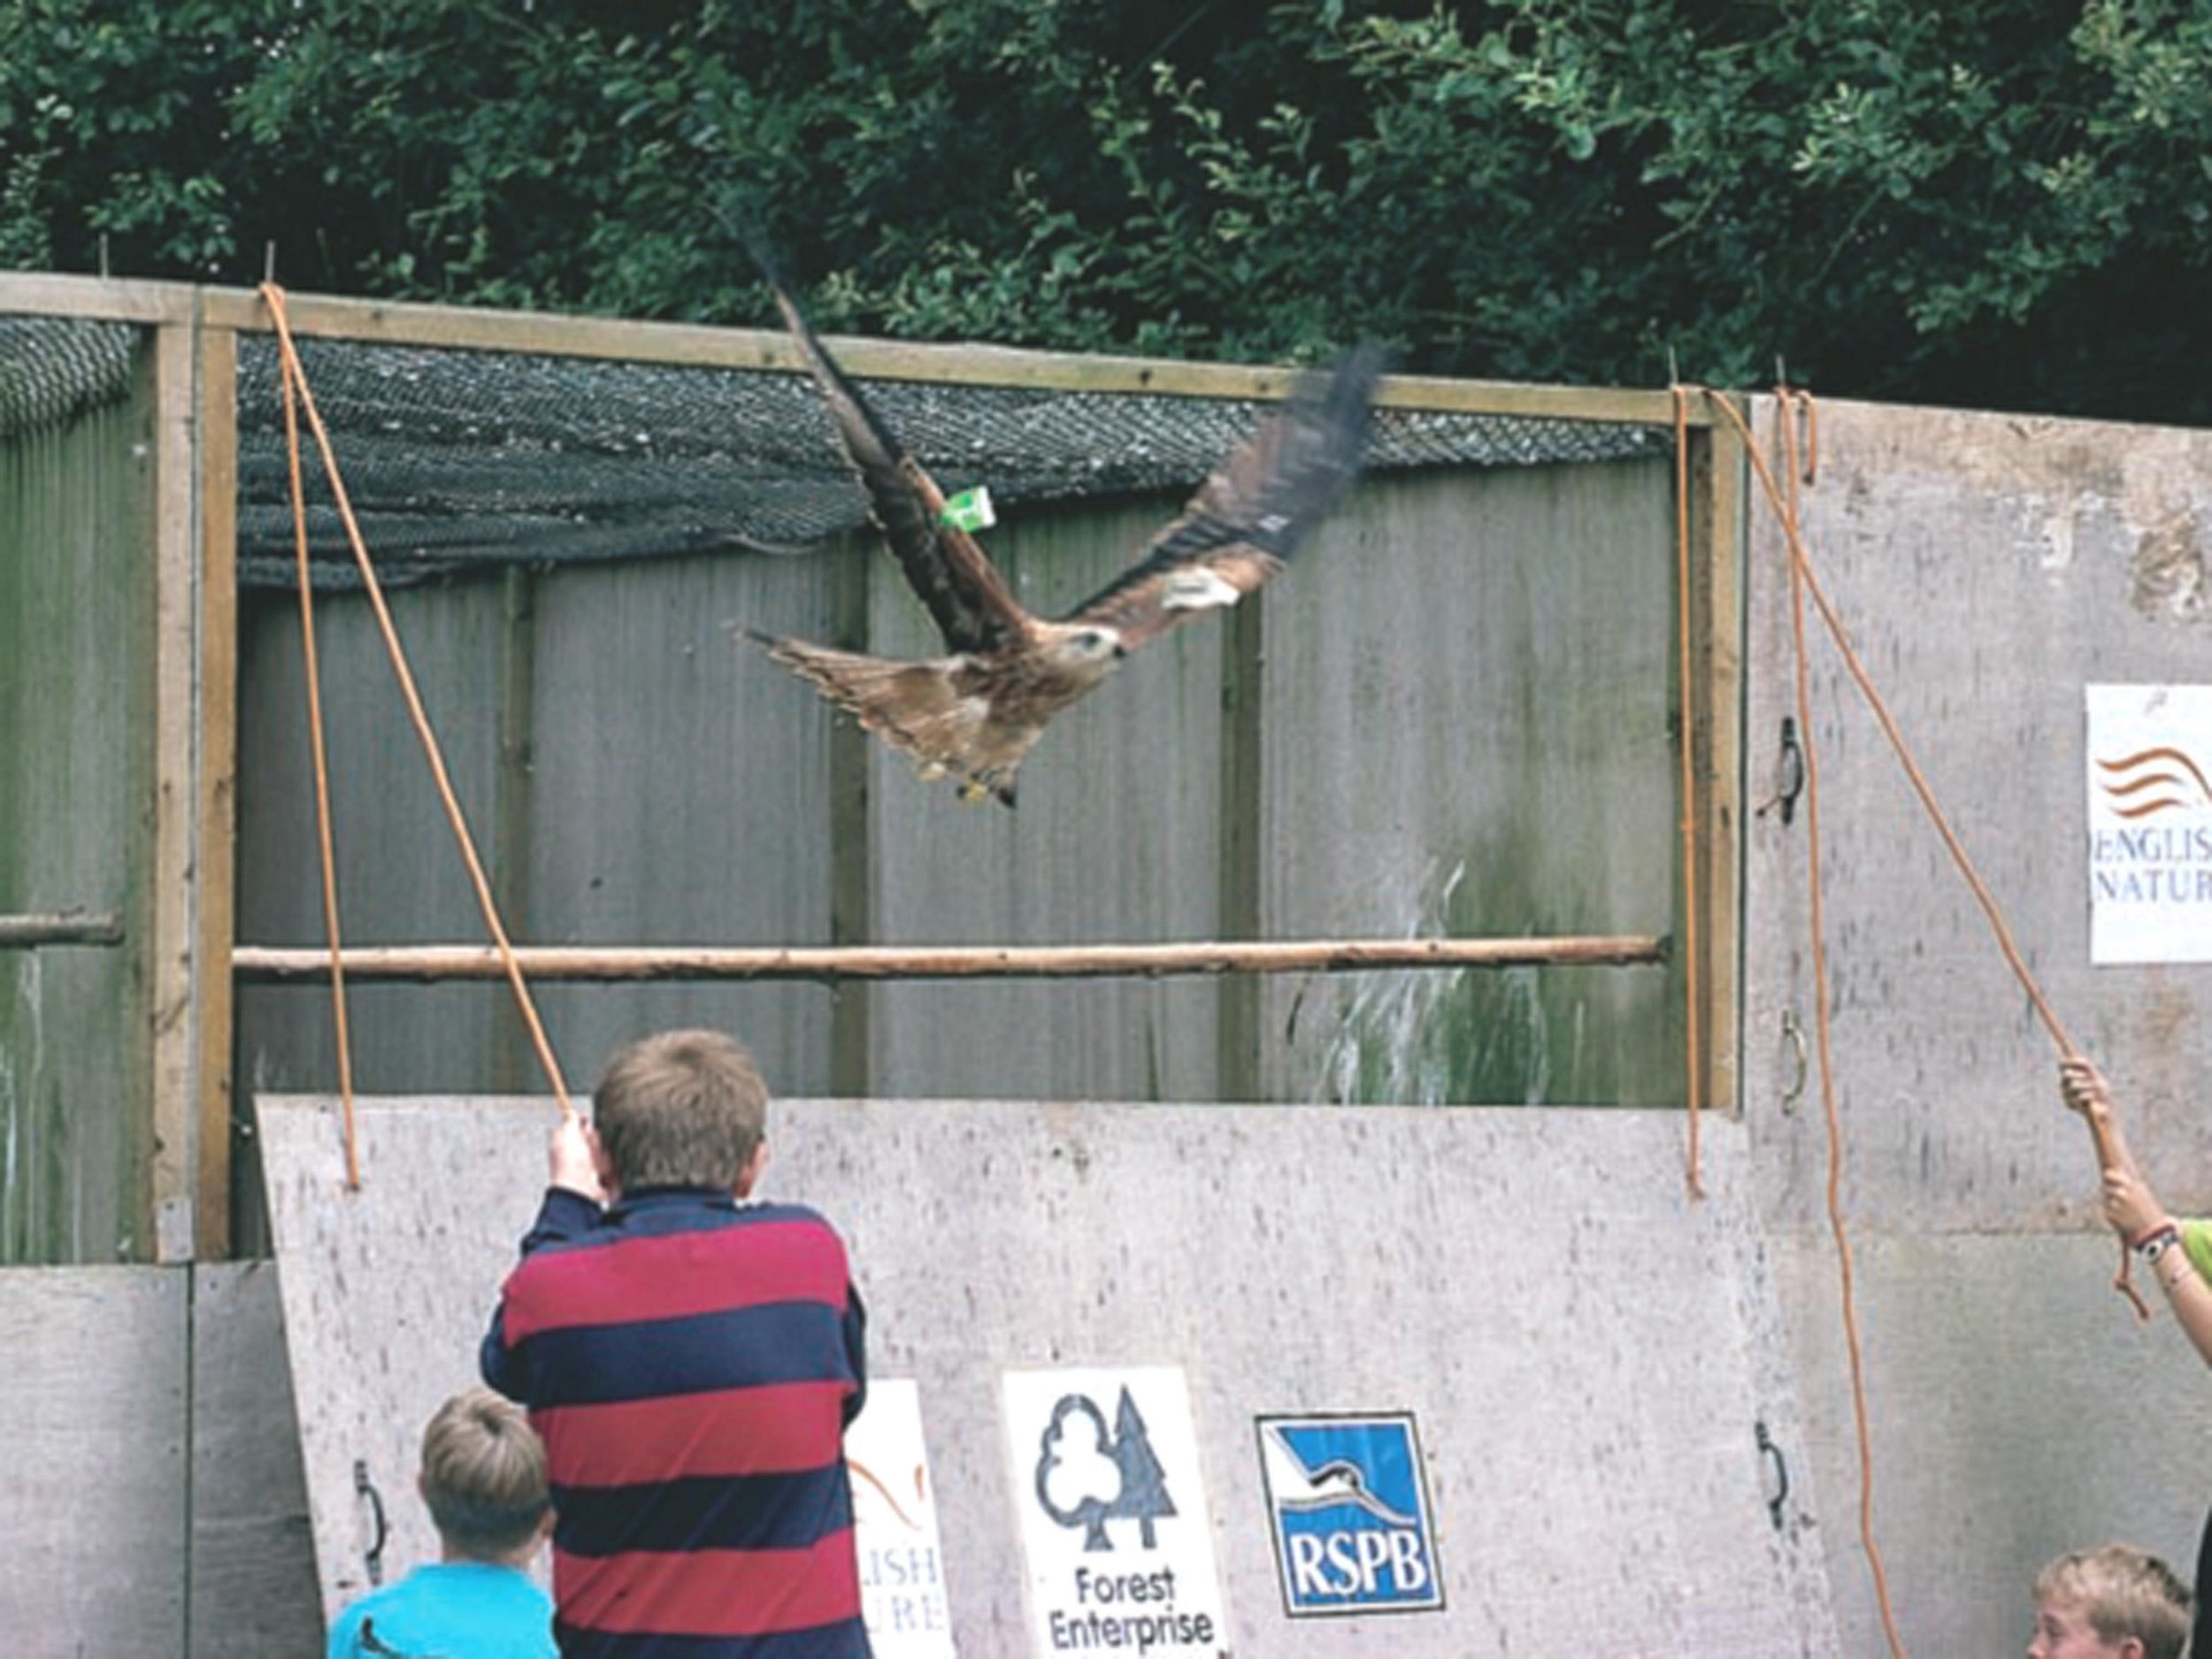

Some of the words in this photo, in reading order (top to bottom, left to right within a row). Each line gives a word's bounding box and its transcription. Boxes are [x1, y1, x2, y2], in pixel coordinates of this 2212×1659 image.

[863, 1547, 937, 1586] ISH
[1073, 1563, 1176, 1605] Forest
[1290, 1531, 1426, 1595] RSPB
[1048, 1602, 1216, 1656] Enterprise
